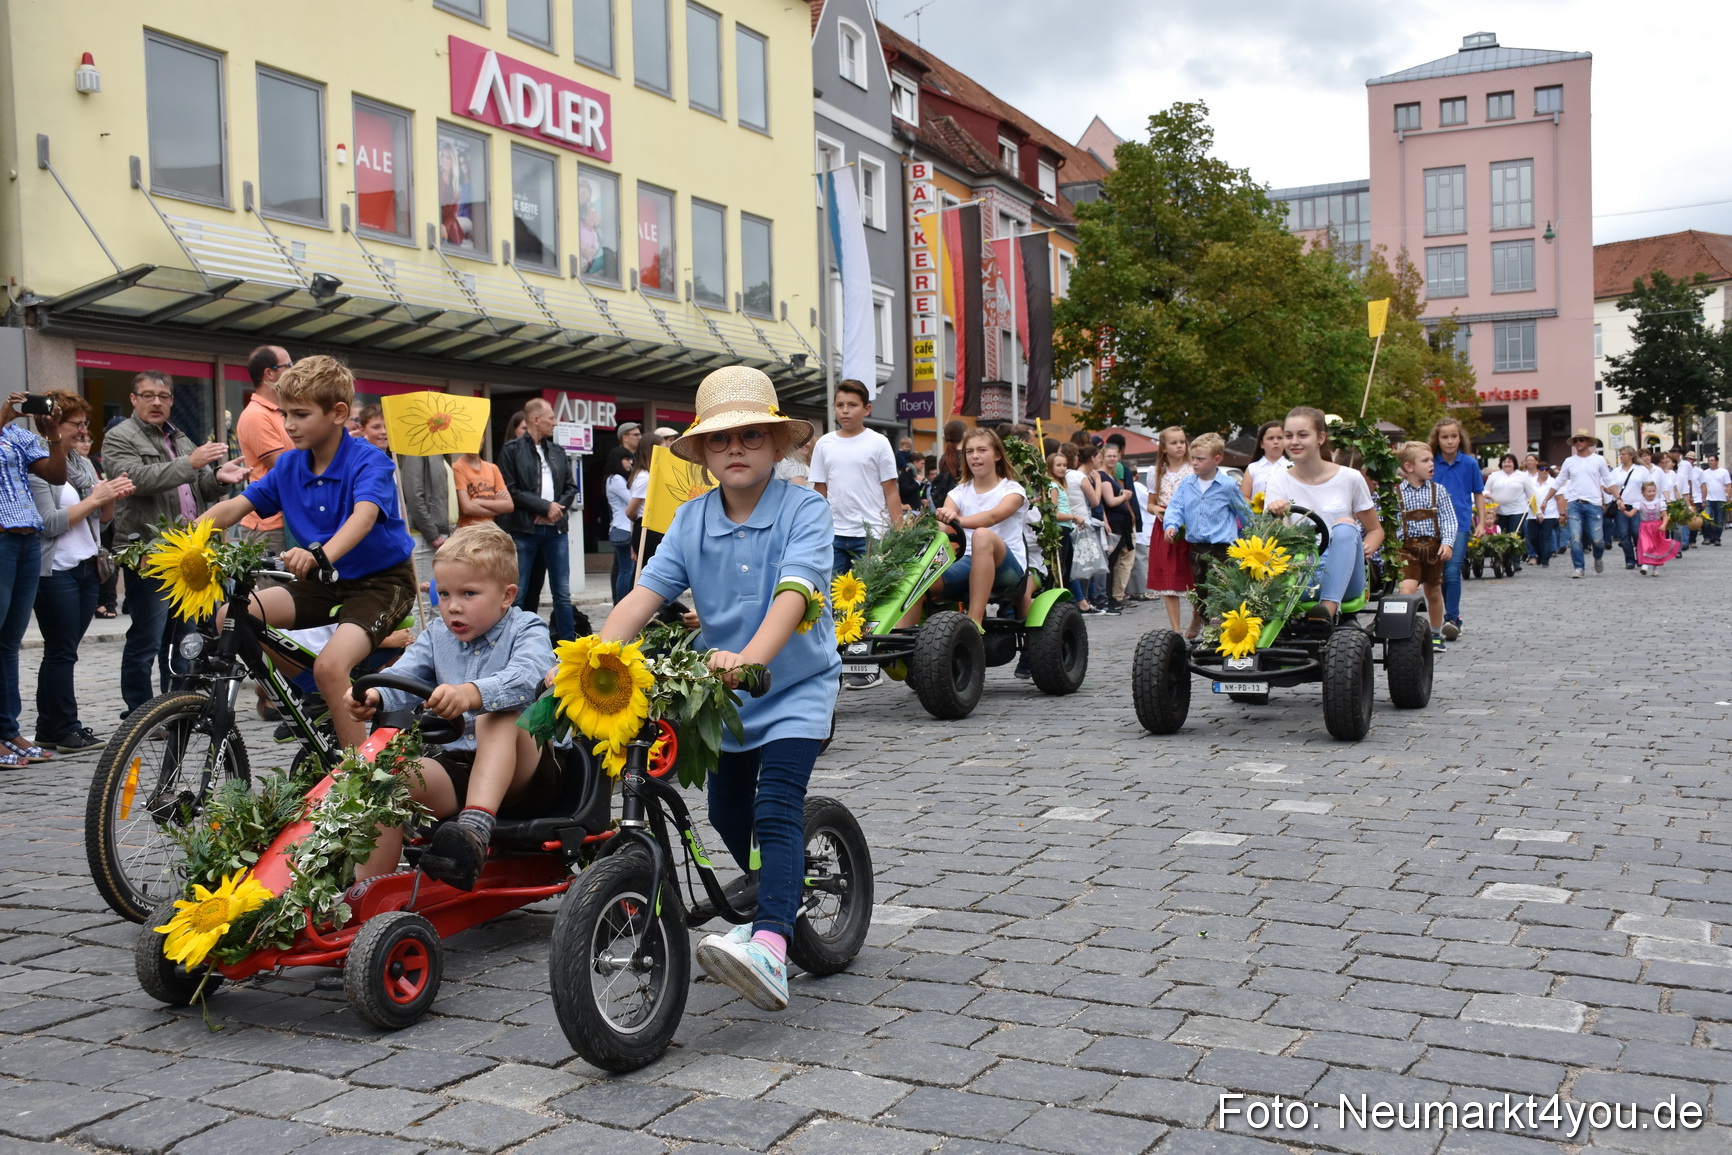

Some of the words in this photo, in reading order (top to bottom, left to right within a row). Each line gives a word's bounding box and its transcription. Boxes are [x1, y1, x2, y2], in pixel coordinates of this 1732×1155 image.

[469, 50, 607, 152] ADLER
[914, 342, 934, 355] café
[900, 398, 933, 413] liberty
[1459, 387, 1540, 404] arkasse
[555, 391, 618, 428] ADLER
[273, 668, 329, 753] BULLS
